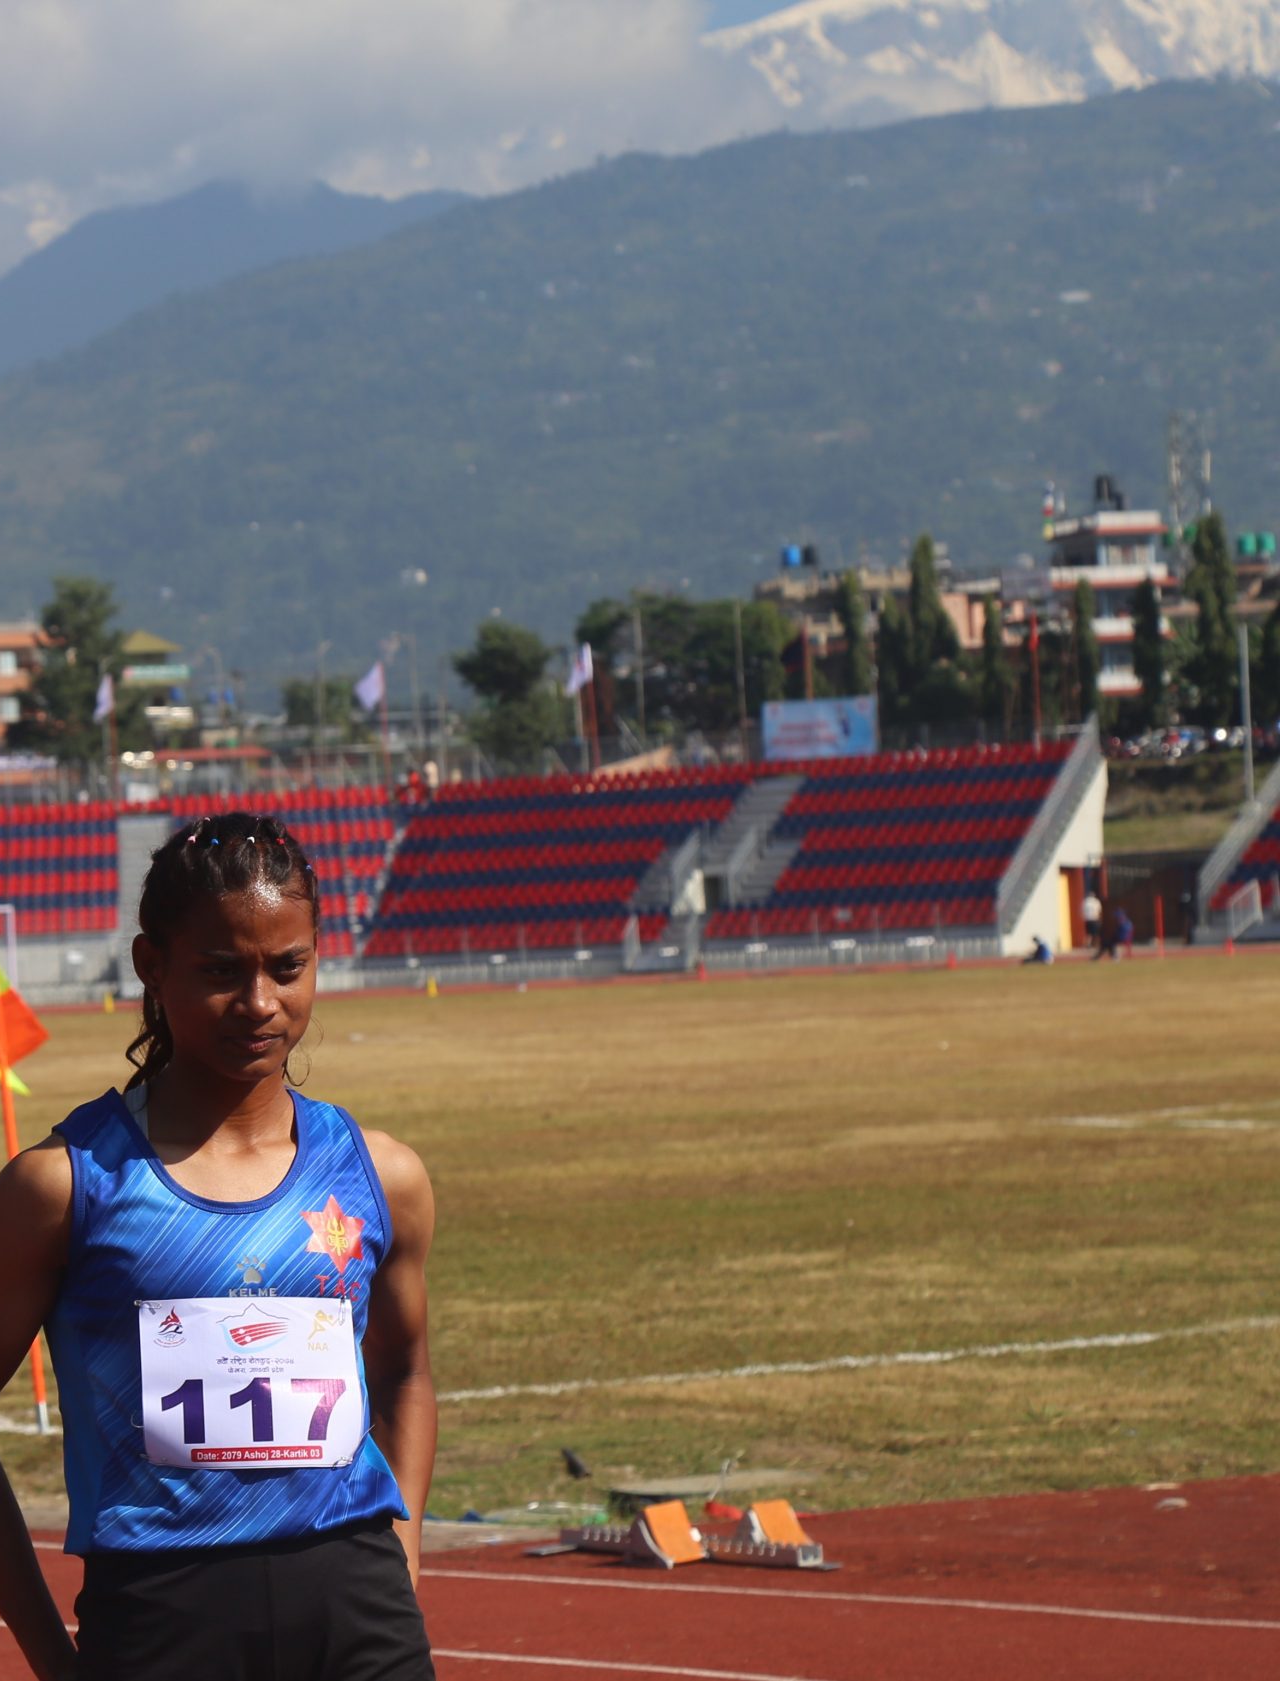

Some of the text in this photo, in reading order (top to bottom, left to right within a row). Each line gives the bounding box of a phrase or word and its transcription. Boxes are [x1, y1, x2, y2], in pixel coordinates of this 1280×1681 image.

[229, 1288, 278, 1297] KELME
[314, 1275, 361, 1302] TAC
[307, 1342, 329, 1351] NAA
[161, 1377, 346, 1444] 117
[196, 1449, 320, 1461] Date: 2079 Ashoj 28-Kartik 03
